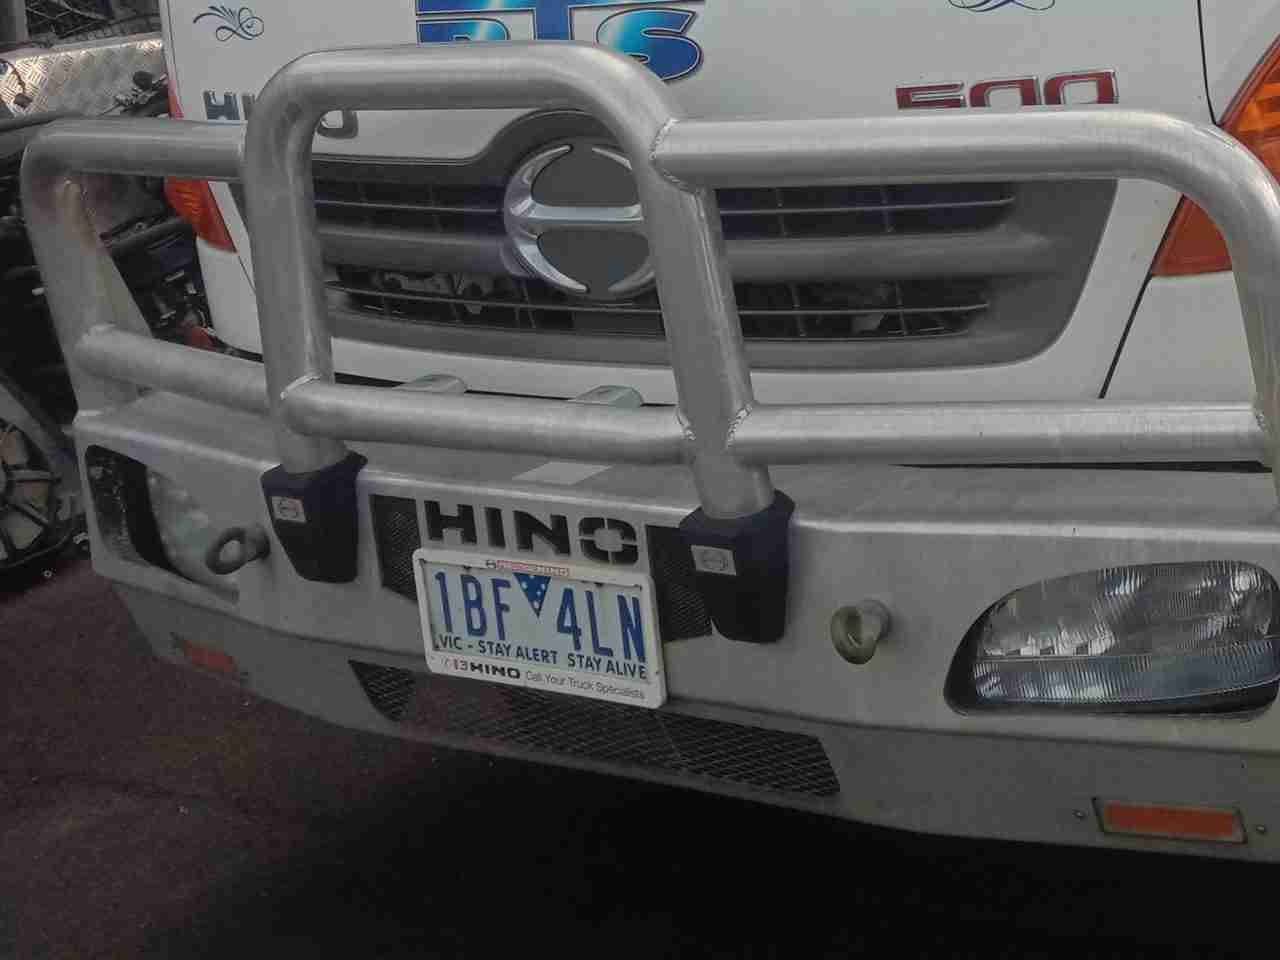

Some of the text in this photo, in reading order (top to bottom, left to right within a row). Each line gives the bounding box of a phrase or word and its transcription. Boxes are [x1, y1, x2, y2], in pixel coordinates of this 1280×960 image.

[423, 499, 640, 565] HINO
[439, 635, 462, 650] VIC
[478, 640, 511, 657] STAY
[515, 645, 558, 664] ALERT
[567, 653, 601, 672] STAY
[606, 660, 647, 679] ALIVE
